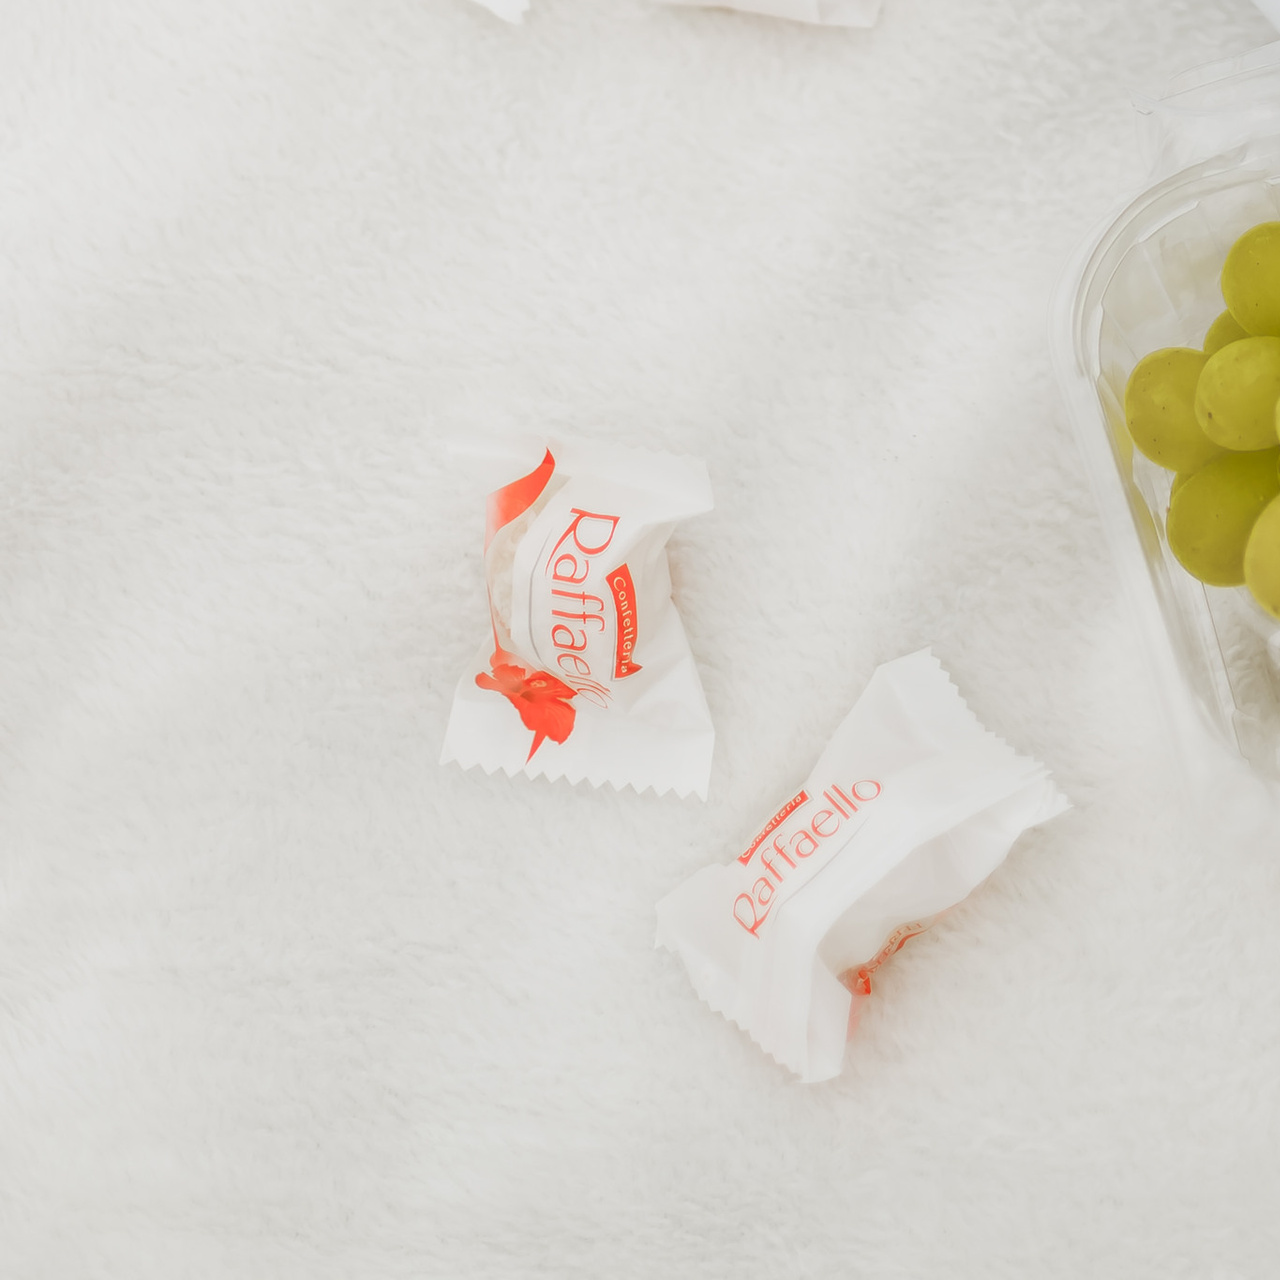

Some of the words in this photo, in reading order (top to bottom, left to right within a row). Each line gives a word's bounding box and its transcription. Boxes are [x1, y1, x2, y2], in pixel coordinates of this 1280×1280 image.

[544, 507, 622, 709] Raffaello
[613, 576, 634, 673] Confetteria
[732, 778, 883, 940] Raffaello
